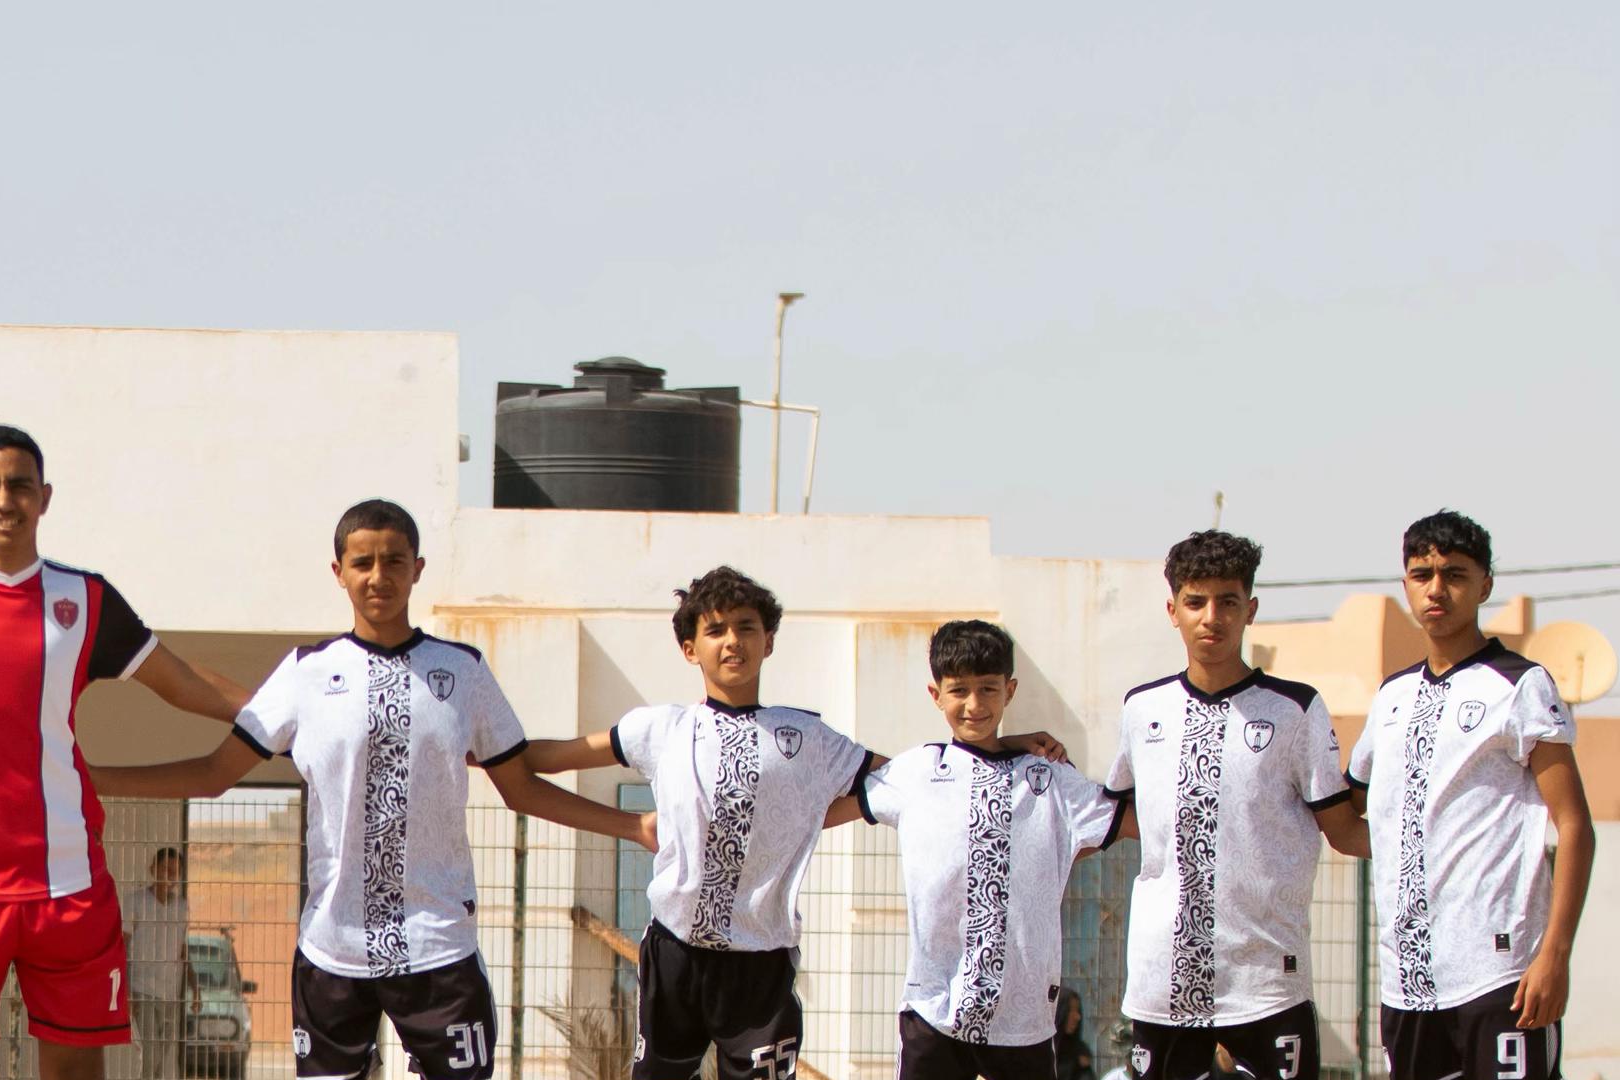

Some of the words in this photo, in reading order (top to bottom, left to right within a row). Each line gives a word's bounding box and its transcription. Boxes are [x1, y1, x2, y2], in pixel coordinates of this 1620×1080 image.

[109, 967, 121, 1011] 1
[446, 1021, 488, 1069] 31
[1275, 1034, 1301, 1080] 3
[1496, 1031, 1526, 1080] 9
